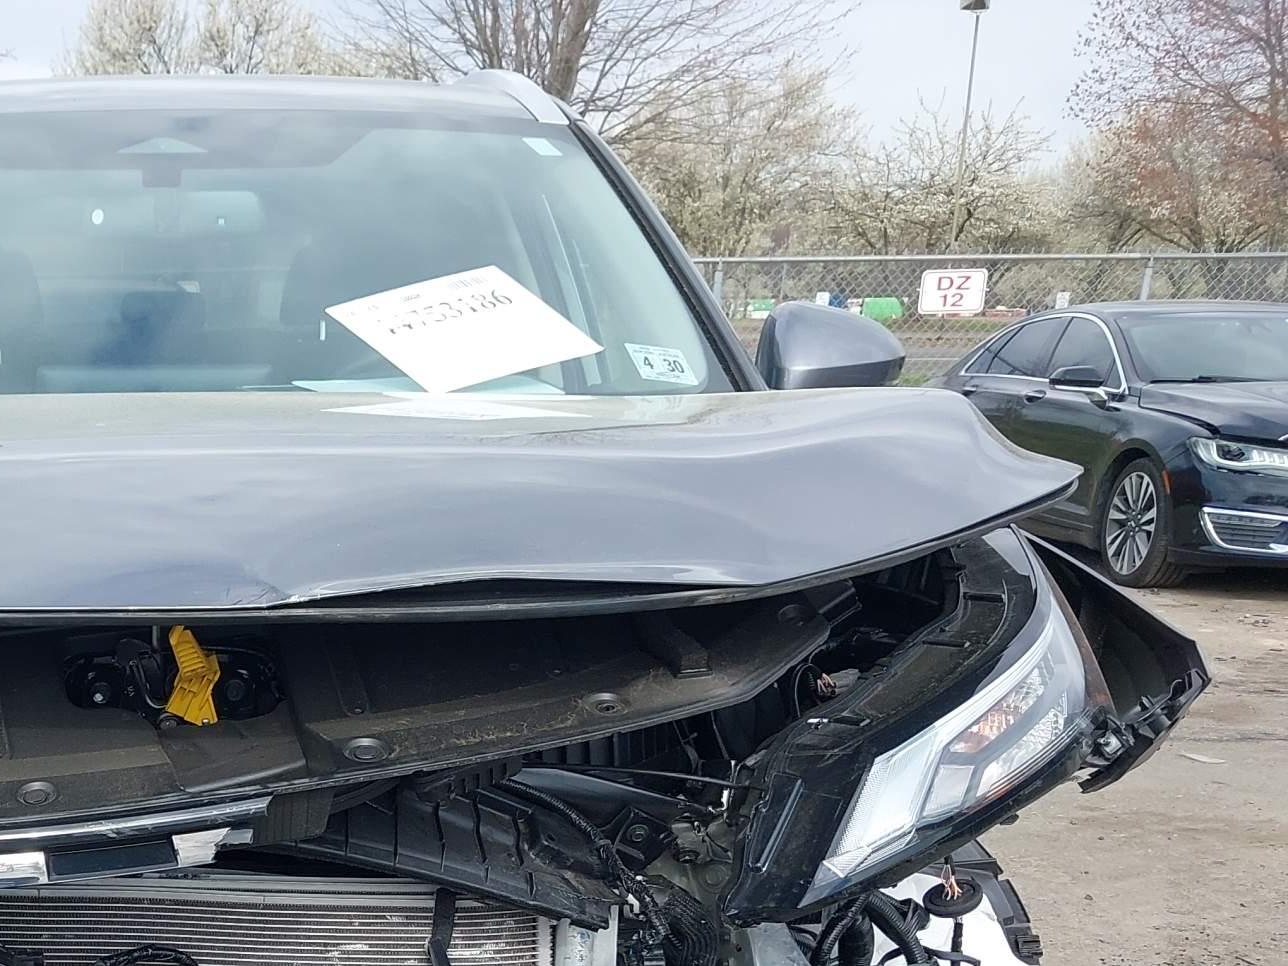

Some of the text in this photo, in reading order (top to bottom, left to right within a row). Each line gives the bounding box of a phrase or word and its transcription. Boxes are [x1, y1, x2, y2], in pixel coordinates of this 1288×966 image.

[936, 274, 970, 291] DZ
[939, 291, 964, 307] 12
[643, 355, 685, 373] 4 30
